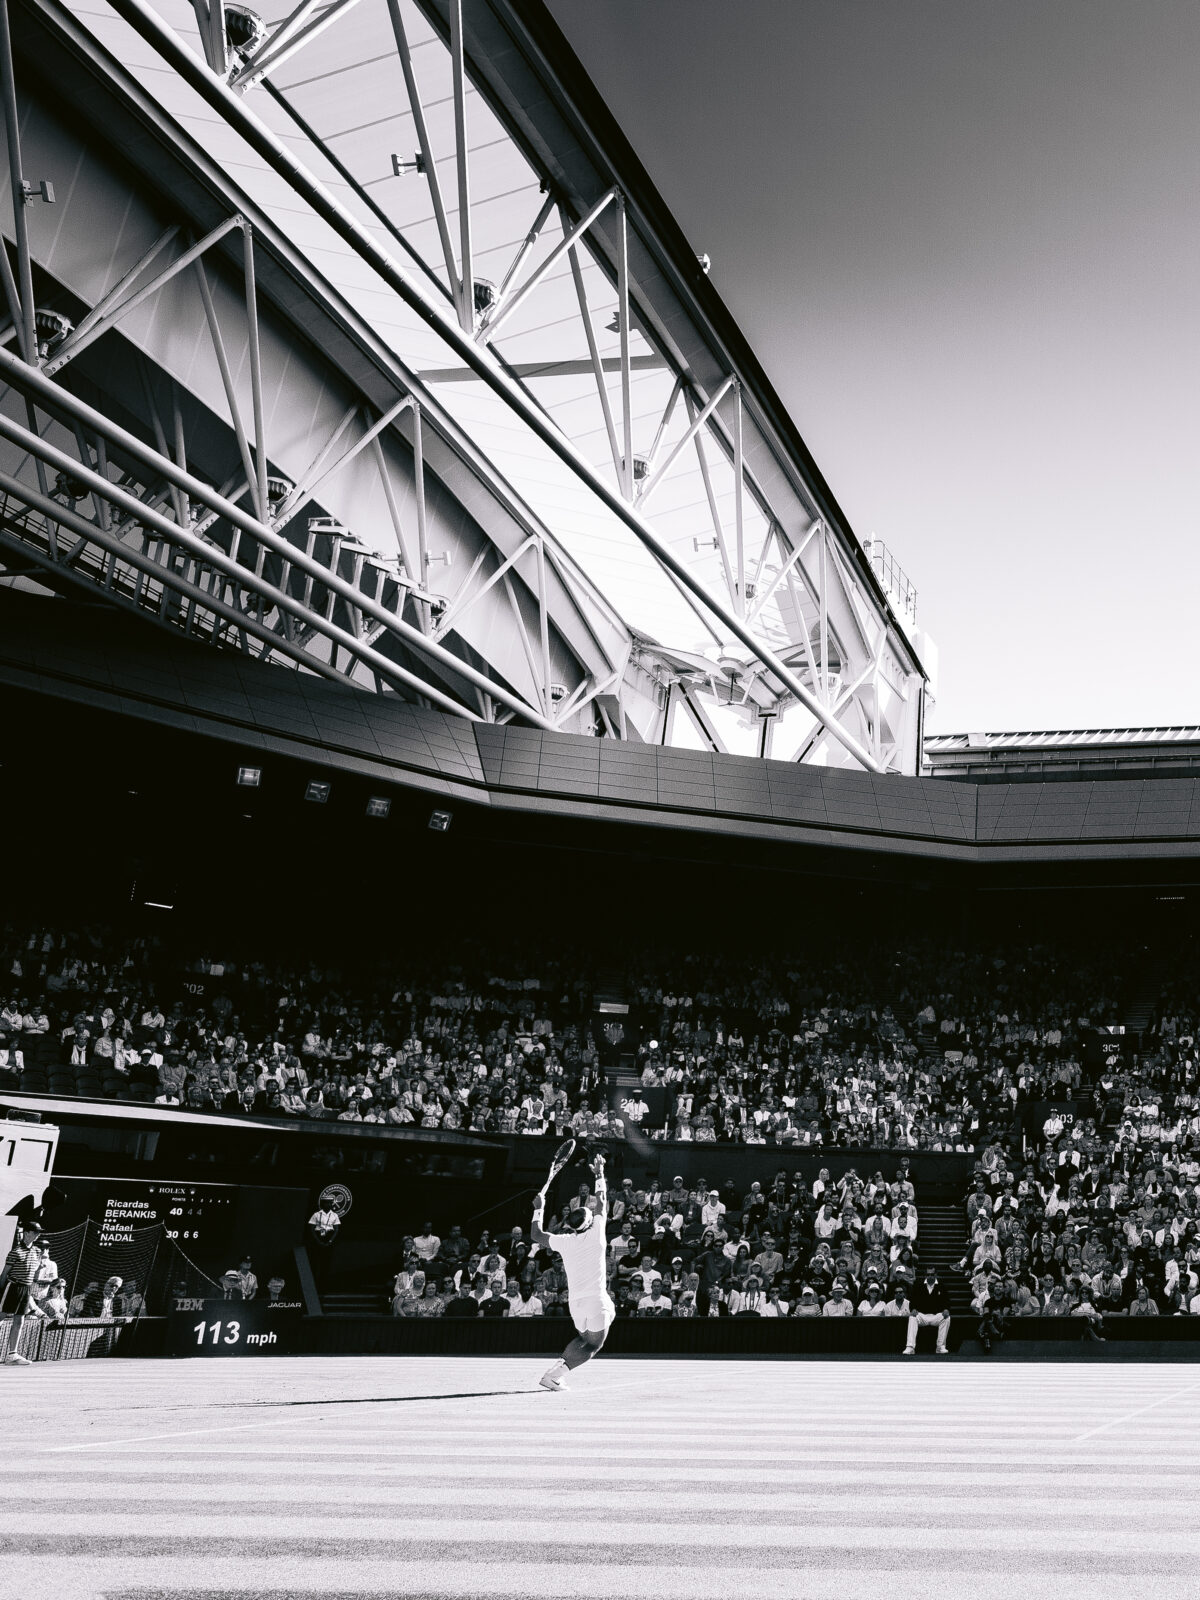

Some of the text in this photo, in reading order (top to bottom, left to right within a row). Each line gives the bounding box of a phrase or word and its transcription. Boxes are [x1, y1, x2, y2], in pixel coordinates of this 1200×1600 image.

[159, 1187, 186, 1195] ROLEX
[106, 1199, 149, 1209] Ricardas
[104, 1209, 157, 1219] BERANKIS
[169, 1207, 183, 1216] 40
[102, 1223, 134, 1232] Rafael
[100, 1230, 199, 1242] NADAL 30 6 6
[175, 1298, 205, 1311] IBM
[193, 1320, 277, 1347] 113 mph
